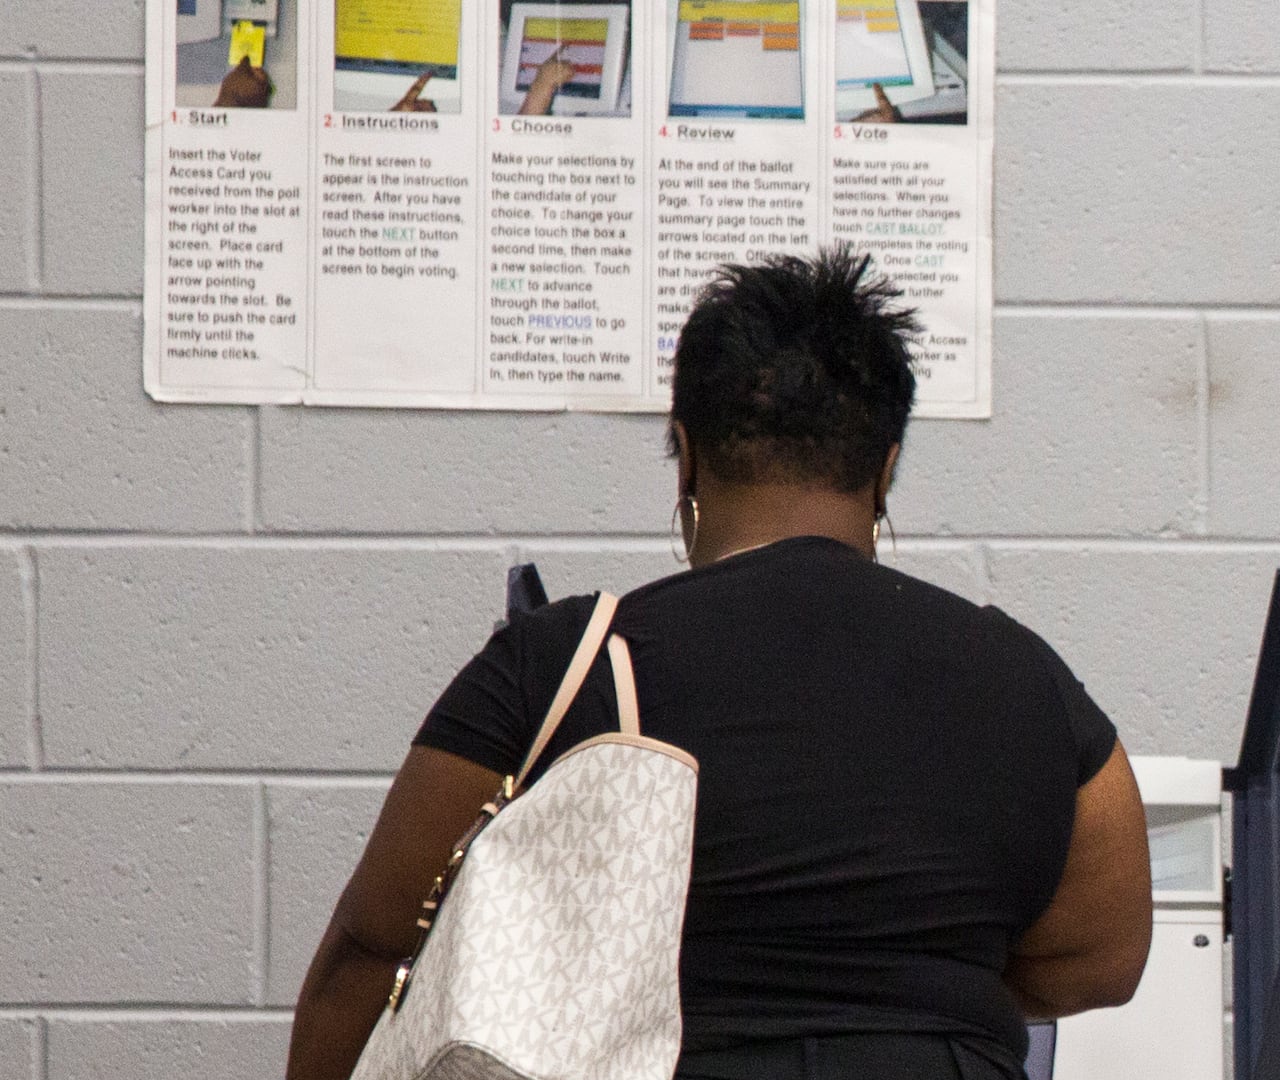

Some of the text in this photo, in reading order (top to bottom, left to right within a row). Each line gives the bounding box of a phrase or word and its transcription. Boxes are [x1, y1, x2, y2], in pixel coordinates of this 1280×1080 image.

[189, 111, 228, 125] Start
[342, 115, 440, 130] Instructions
[510, 119, 573, 134] Choose
[677, 125, 735, 139] Review
[852, 127, 889, 140] Vote
[168, 148, 262, 162] Insert the Voter
[323, 153, 416, 168] The first screen
[491, 152, 618, 168] Make your selections
[674, 159, 794, 173] the end the ballot
[832, 158, 930, 172] Make sure you are
[169, 165, 272, 183] Access Card you
[322, 174, 469, 187] appear the instruction
[491, 171, 621, 186] touching the box next
[658, 177, 811, 193] you will see the Summary
[832, 174, 945, 189] satisfied with all your
[168, 185, 301, 202] received from the poll
[373, 191, 462, 206] After you have
[491, 189, 617, 205] the candidate your
[896, 191, 949, 205] When you
[717, 196, 804, 209] view the entire
[168, 203, 286, 217] worker into the slot
[322, 208, 386, 221] read these
[560, 209, 634, 224] change your
[832, 207, 962, 222] have further changes
[168, 220, 258, 236] the right the
[658, 214, 806, 229] summary page touch the
[831, 222, 896, 235] touch CAST
[321, 226, 459, 241] touch the NEXT button
[490, 225, 616, 239] choice touch the box
[657, 232, 809, 245] arrows located the left
[219, 239, 284, 253] Place card
[336, 245, 440, 259] the bottom the
[491, 243, 633, 257] second then make
[935, 240, 969, 254] voting
[672, 249, 692, 260] the
[883, 254, 912, 266] Once
[167, 256, 264, 270] face with the
[501, 261, 631, 275] new Touch
[321, 264, 415, 279] screen begin
[657, 266, 681, 278] that
[893, 271, 937, 283] selected
[167, 276, 256, 291] arrow pointing
[491, 278, 593, 292] NEXT advance
[657, 286, 677, 296] are
[908, 287, 945, 298] further
[167, 293, 239, 306] towards the
[490, 297, 561, 312] through the
[167, 312, 297, 325] sure push the card
[490, 314, 592, 329] touch PREVIOUS
[166, 328, 255, 342] firmly until the
[525, 332, 594, 345] For write-in
[928, 335, 968, 346] Access
[166, 347, 219, 359] machine
[562, 351, 631, 364] touch Write
[507, 368, 586, 383] then type the
